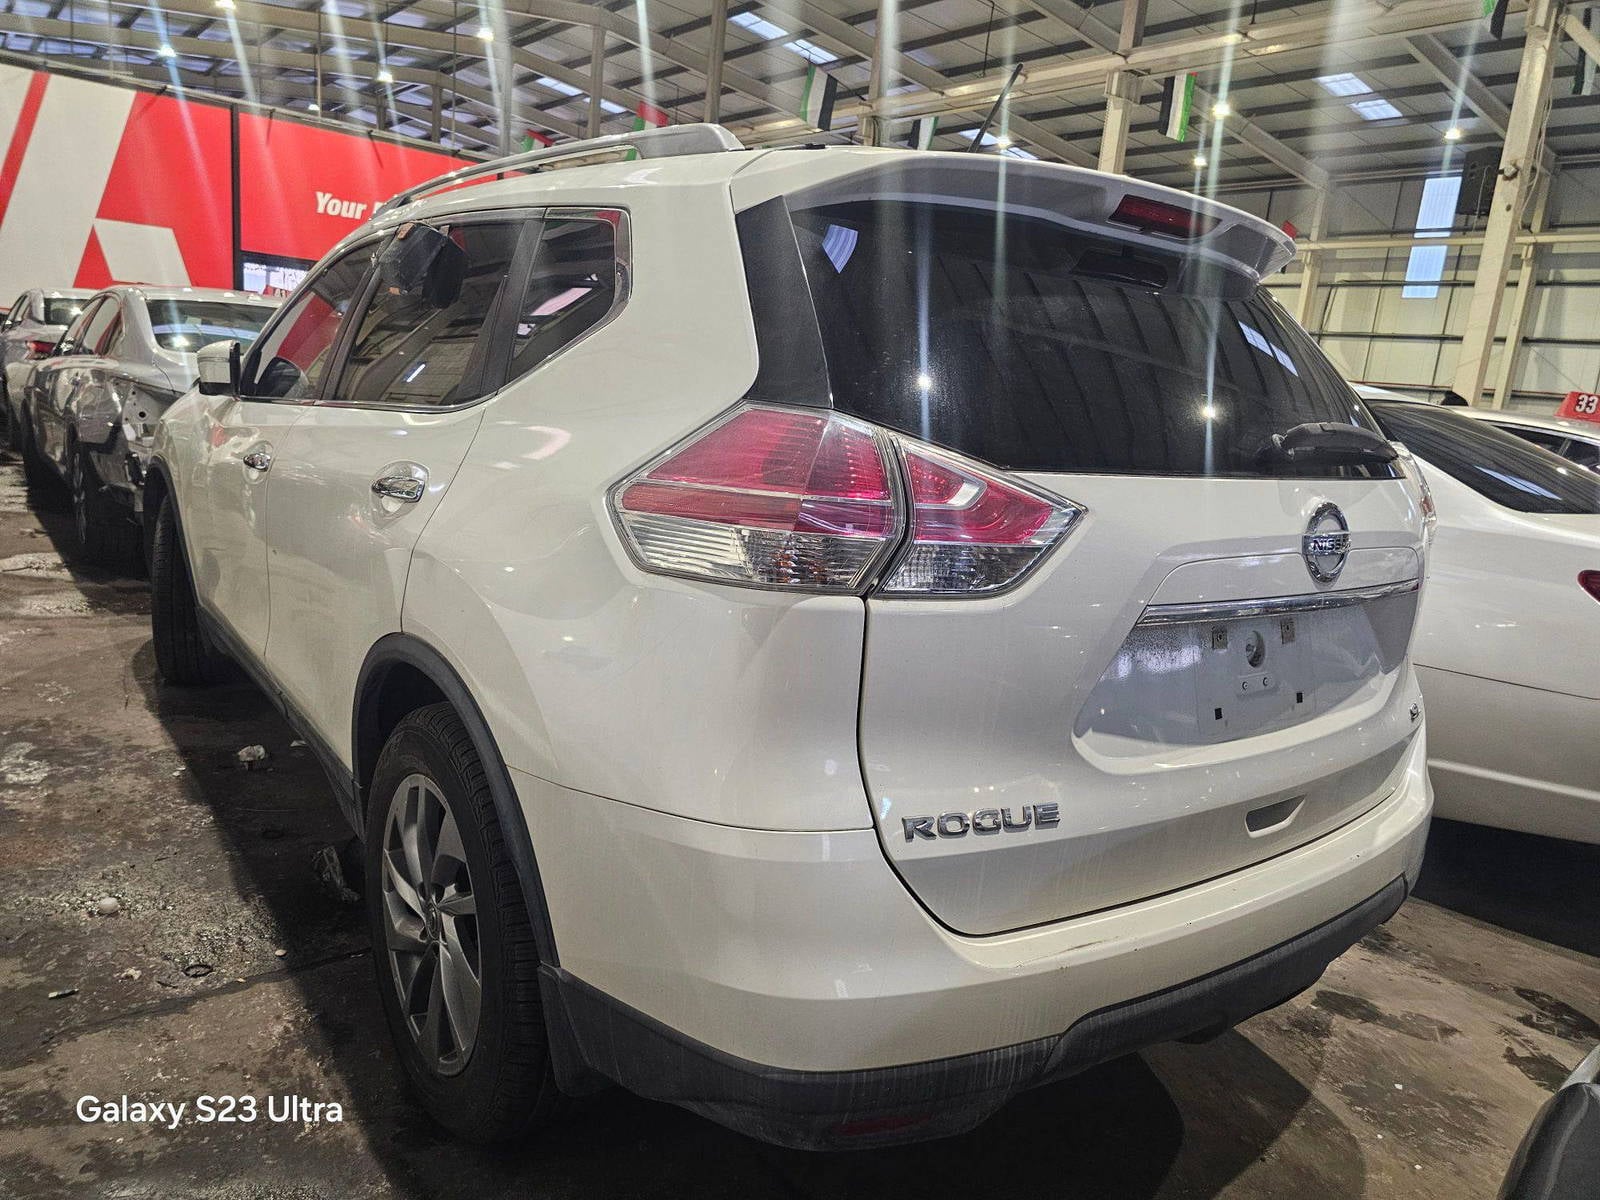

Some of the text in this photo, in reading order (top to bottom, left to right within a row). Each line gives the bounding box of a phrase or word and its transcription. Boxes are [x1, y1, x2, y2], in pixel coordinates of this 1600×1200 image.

[315, 191, 367, 219] Your
[1575, 394, 1599, 414] 33
[901, 803, 1061, 843] ROGUE
